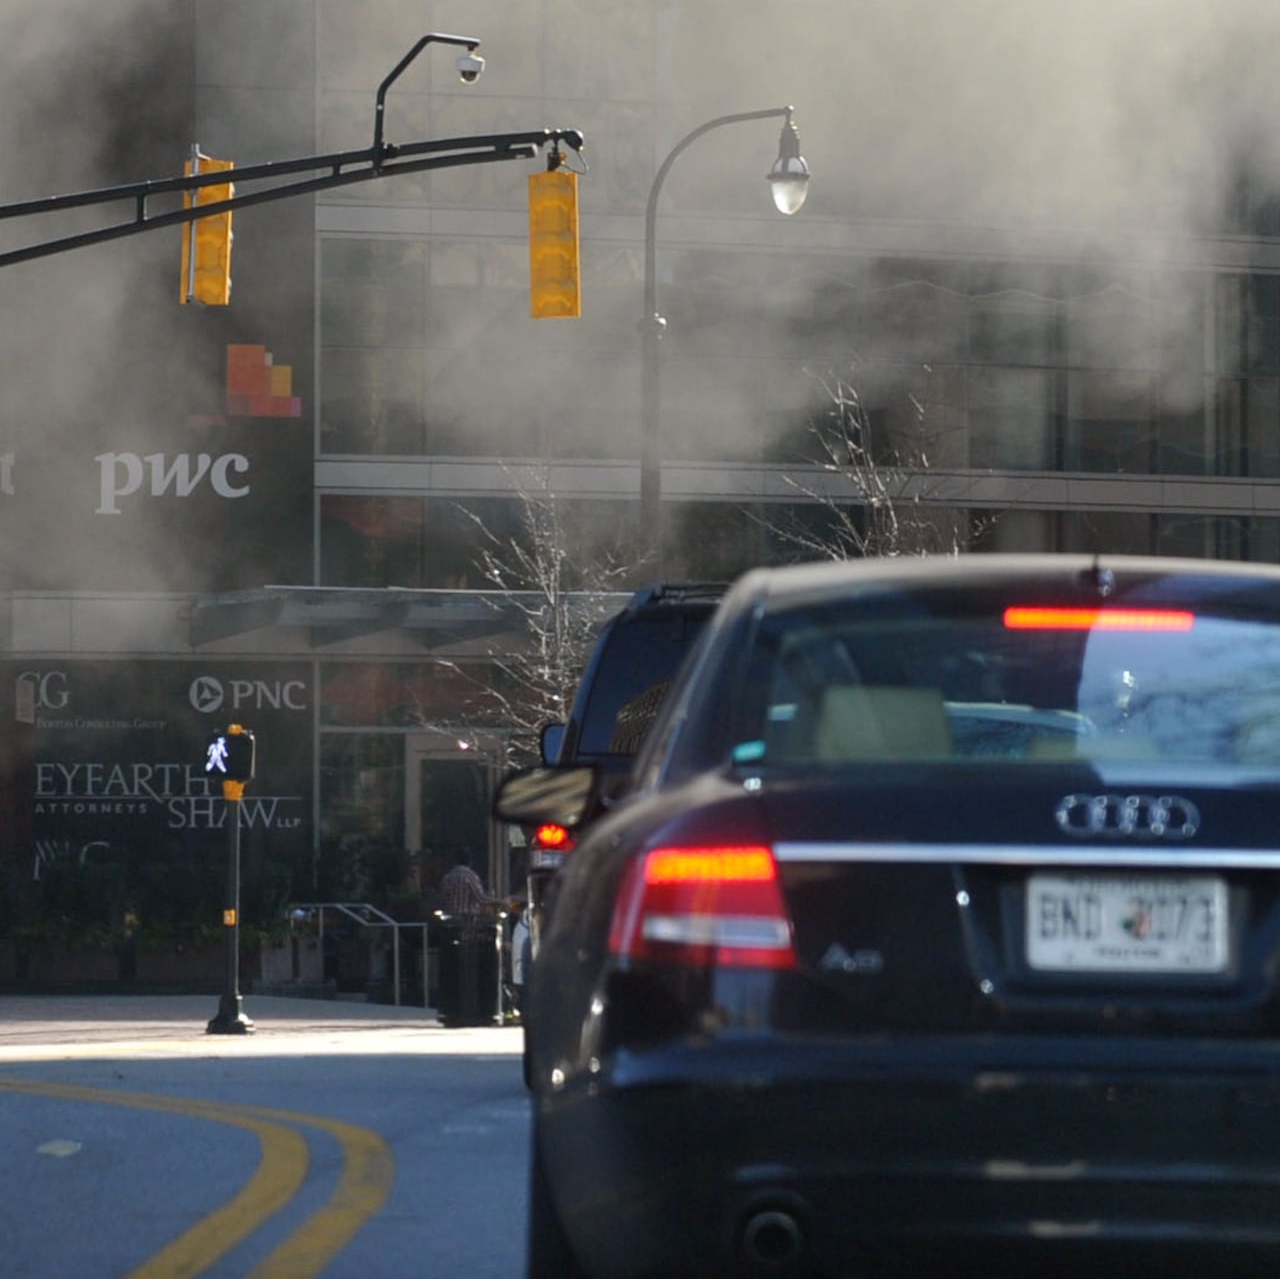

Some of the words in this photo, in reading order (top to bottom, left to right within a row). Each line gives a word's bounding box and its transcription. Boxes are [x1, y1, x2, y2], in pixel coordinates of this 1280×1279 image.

[94, 452, 250, 515] pwc
[229, 680, 307, 710] PNC
[35, 803, 148, 814] ATTORNEYS
